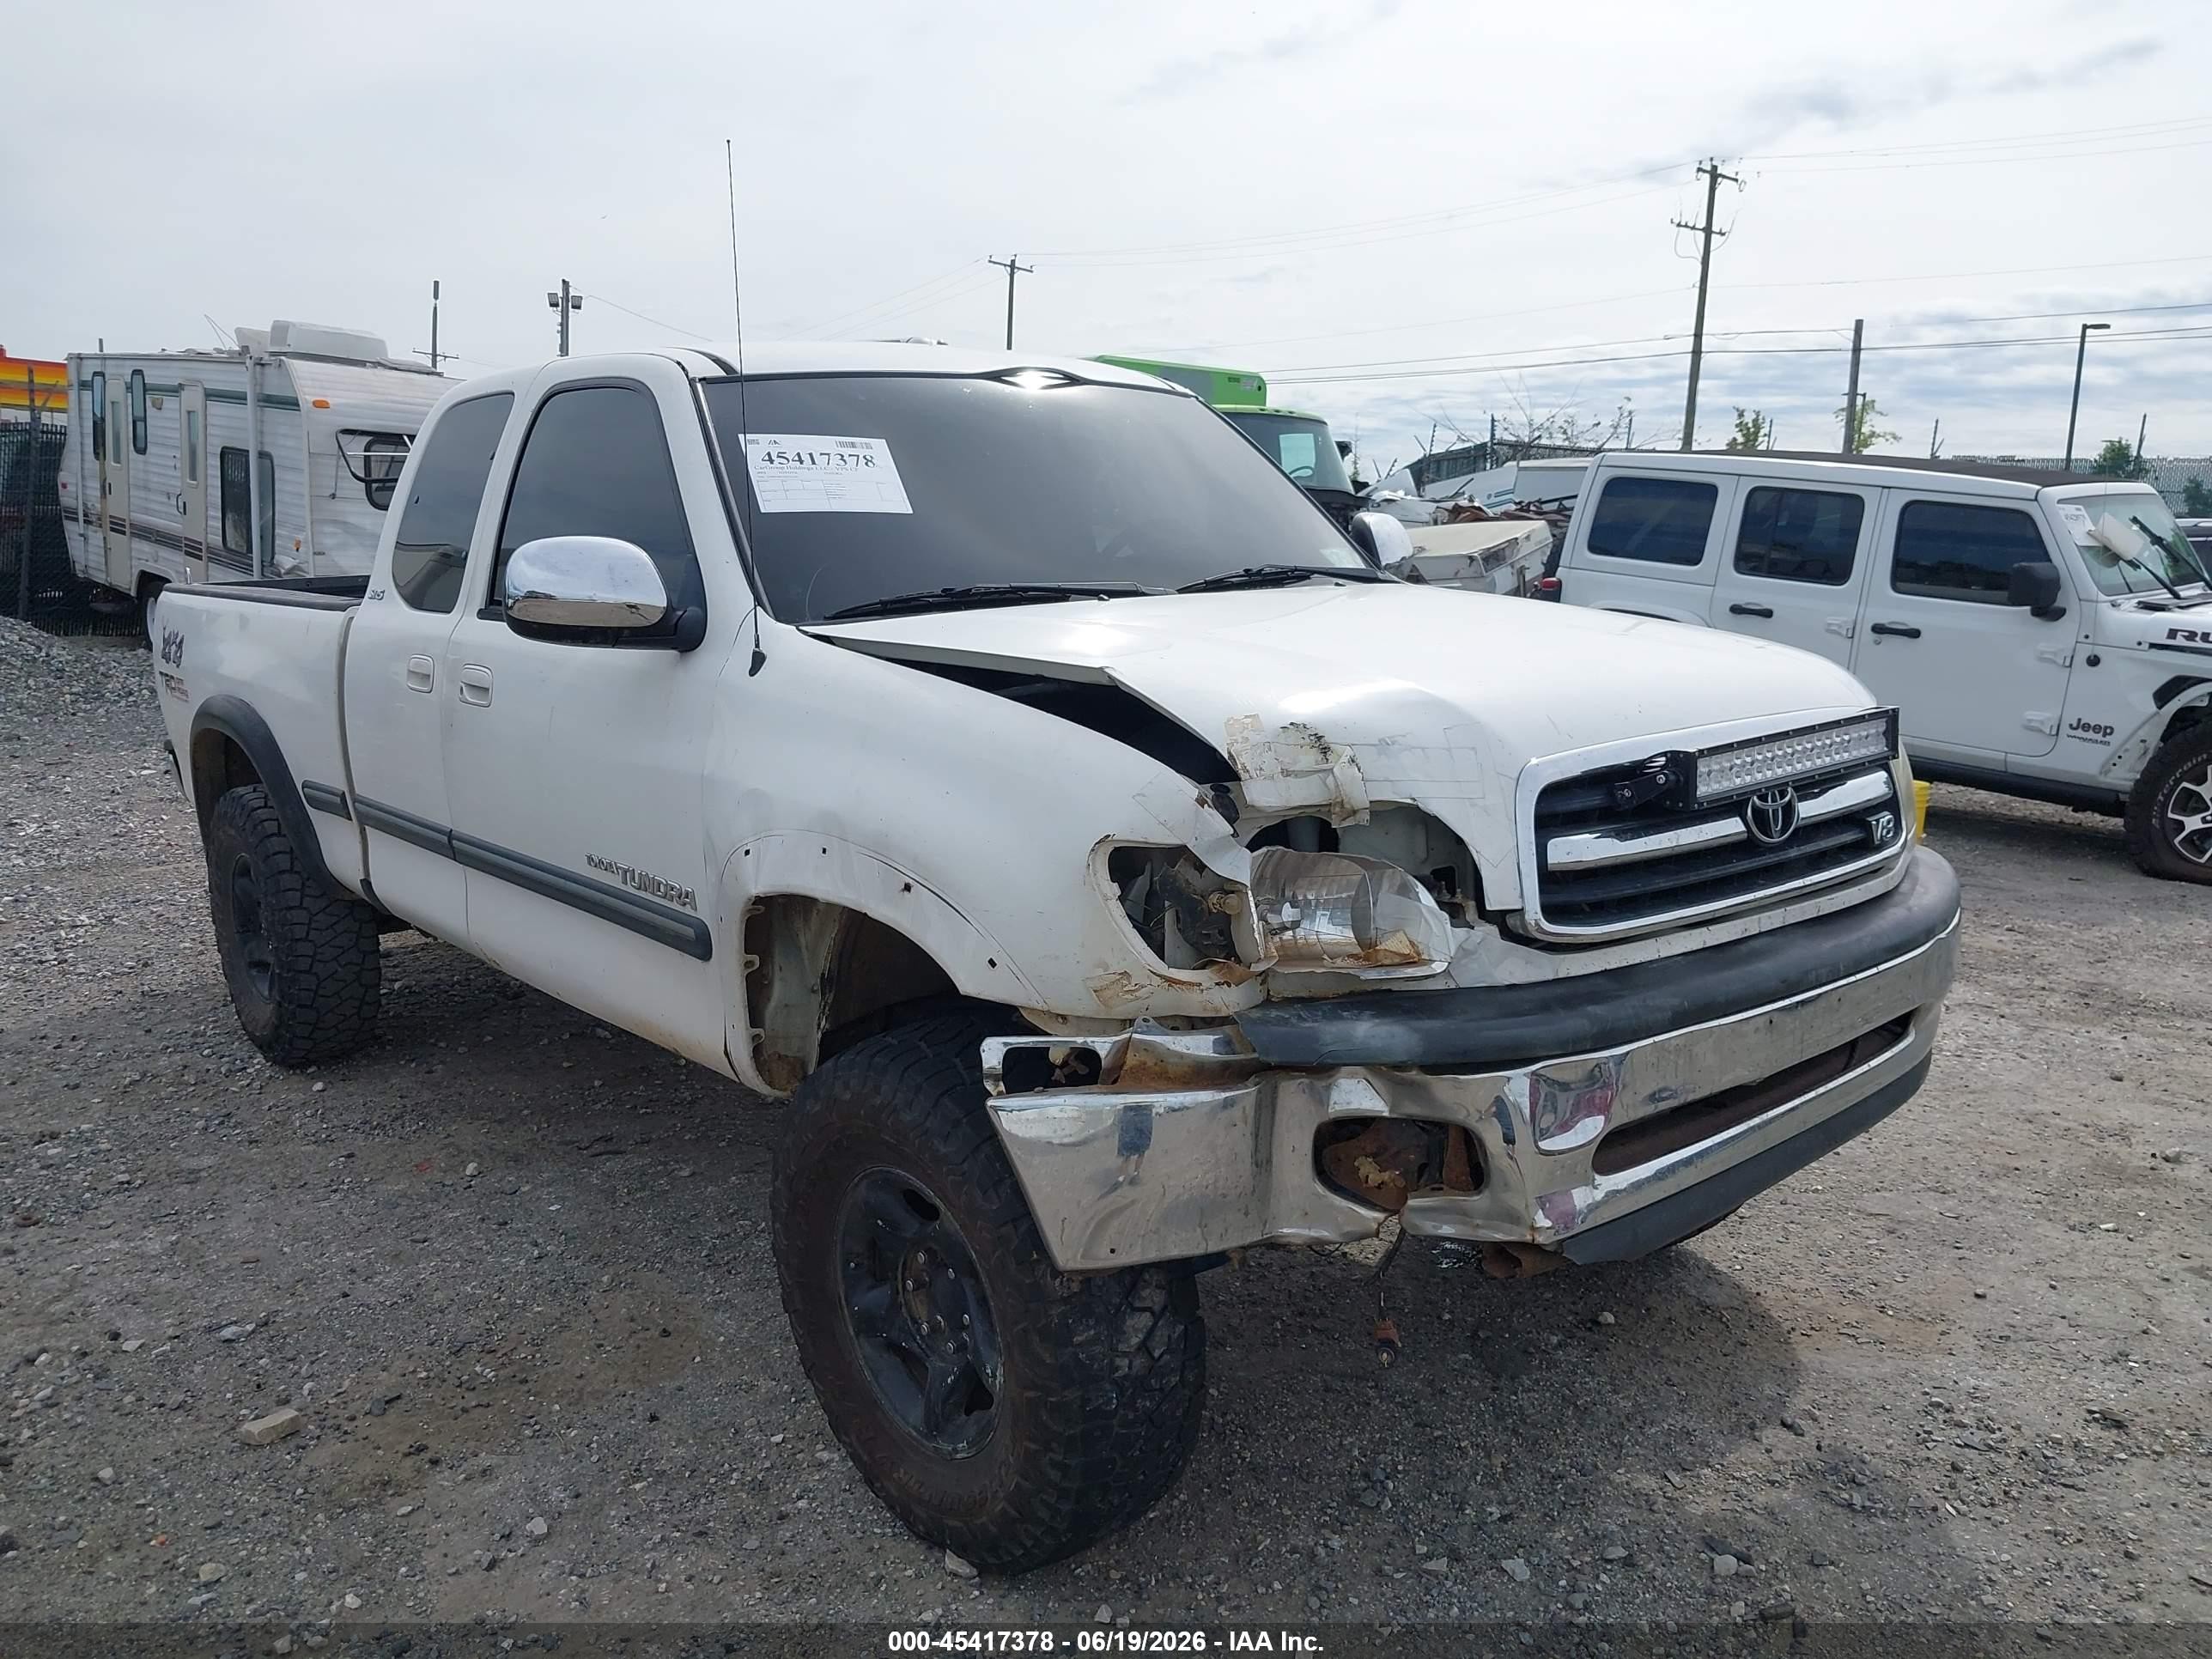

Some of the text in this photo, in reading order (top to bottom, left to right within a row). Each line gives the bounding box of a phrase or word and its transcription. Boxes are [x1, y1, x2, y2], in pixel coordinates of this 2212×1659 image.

[761, 451, 876, 468] 45417378
[2068, 717, 2115, 738] Jeep
[1870, 813, 1895, 845] V8
[584, 852, 698, 913] TOYOTA TUNDRA
